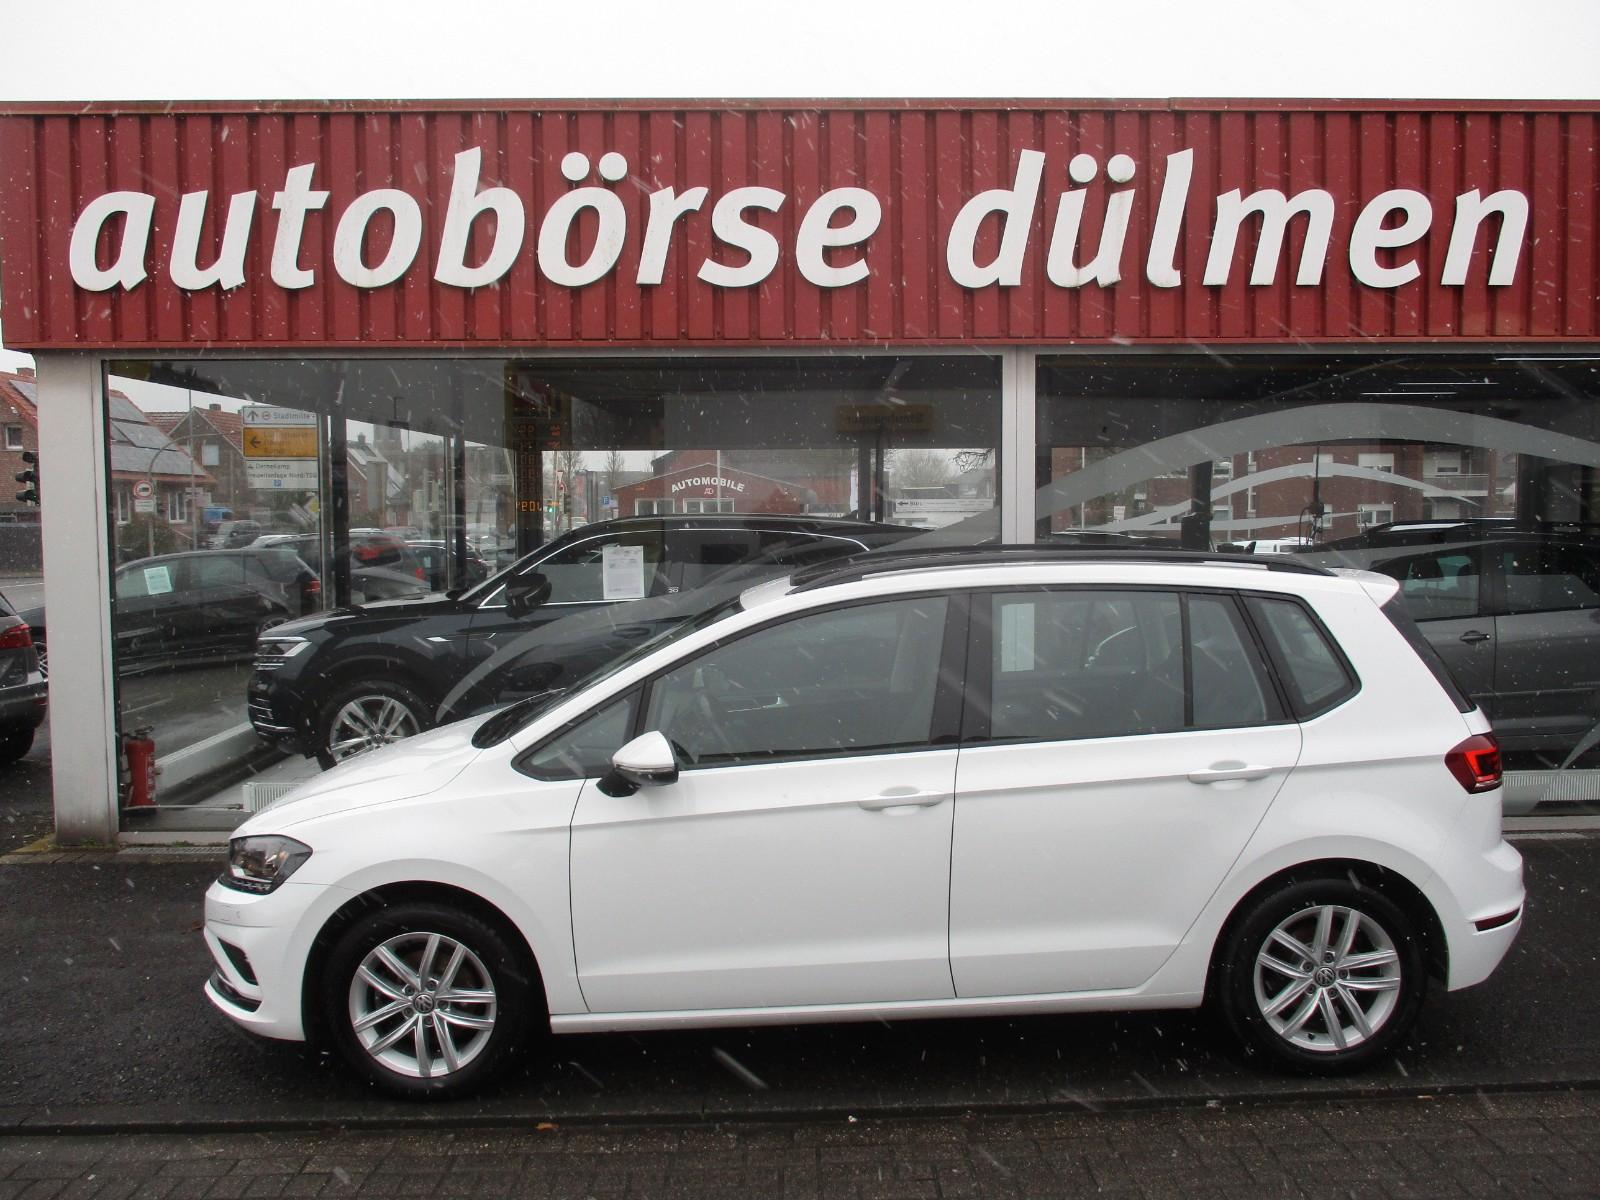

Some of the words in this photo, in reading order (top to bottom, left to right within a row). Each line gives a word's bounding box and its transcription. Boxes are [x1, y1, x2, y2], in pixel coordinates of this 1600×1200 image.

[68, 146, 882, 292] autobörse
[946, 147, 1530, 289] dülmen
[671, 476, 745, 493] AUTOMOBILE
